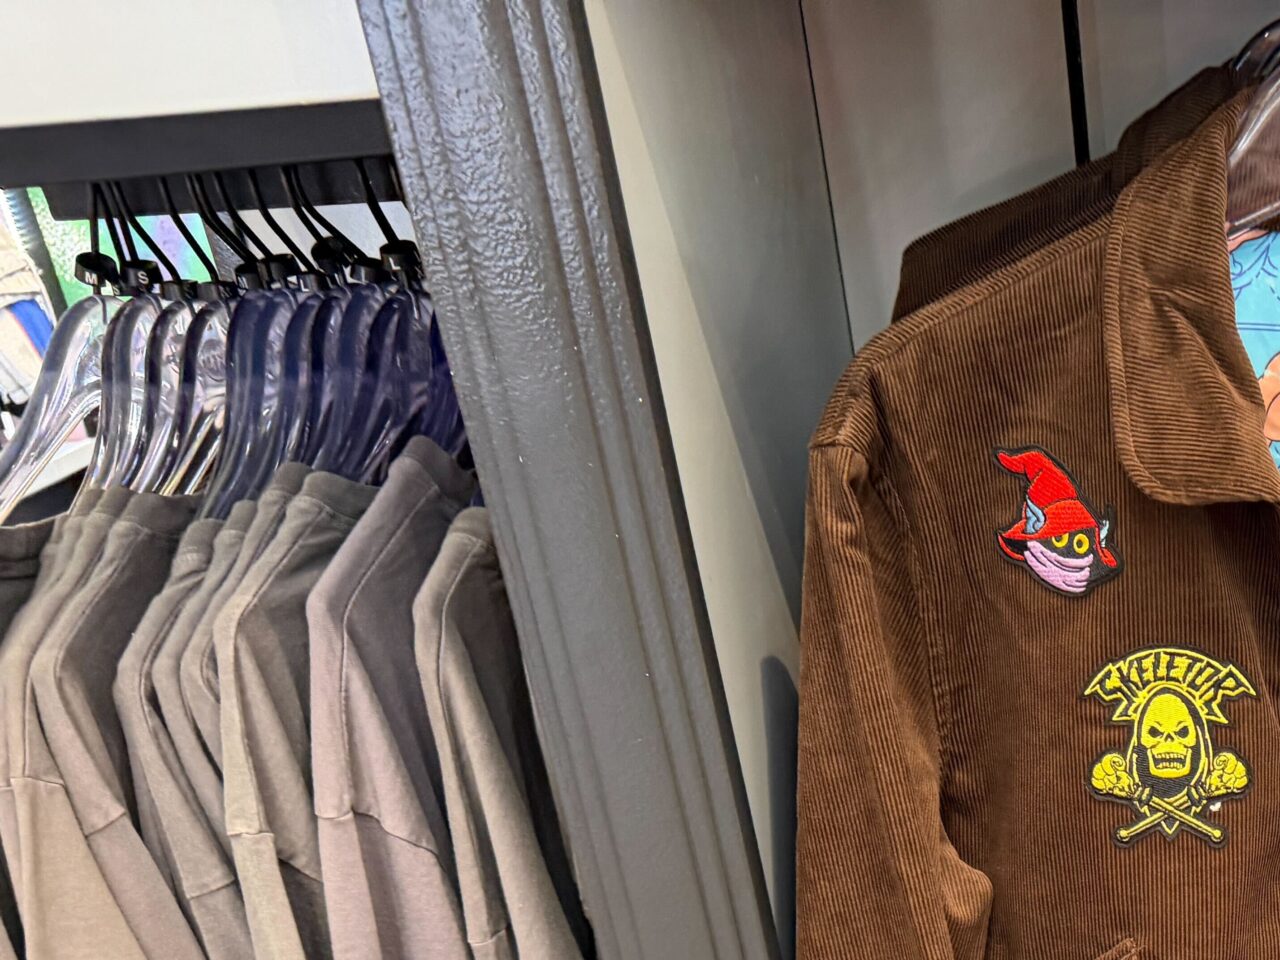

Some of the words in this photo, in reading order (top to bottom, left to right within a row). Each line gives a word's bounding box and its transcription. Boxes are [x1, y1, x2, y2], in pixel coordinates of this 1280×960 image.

[389, 256, 401, 270] L
[85, 271, 98, 285] M
[137, 270, 149, 285] S
